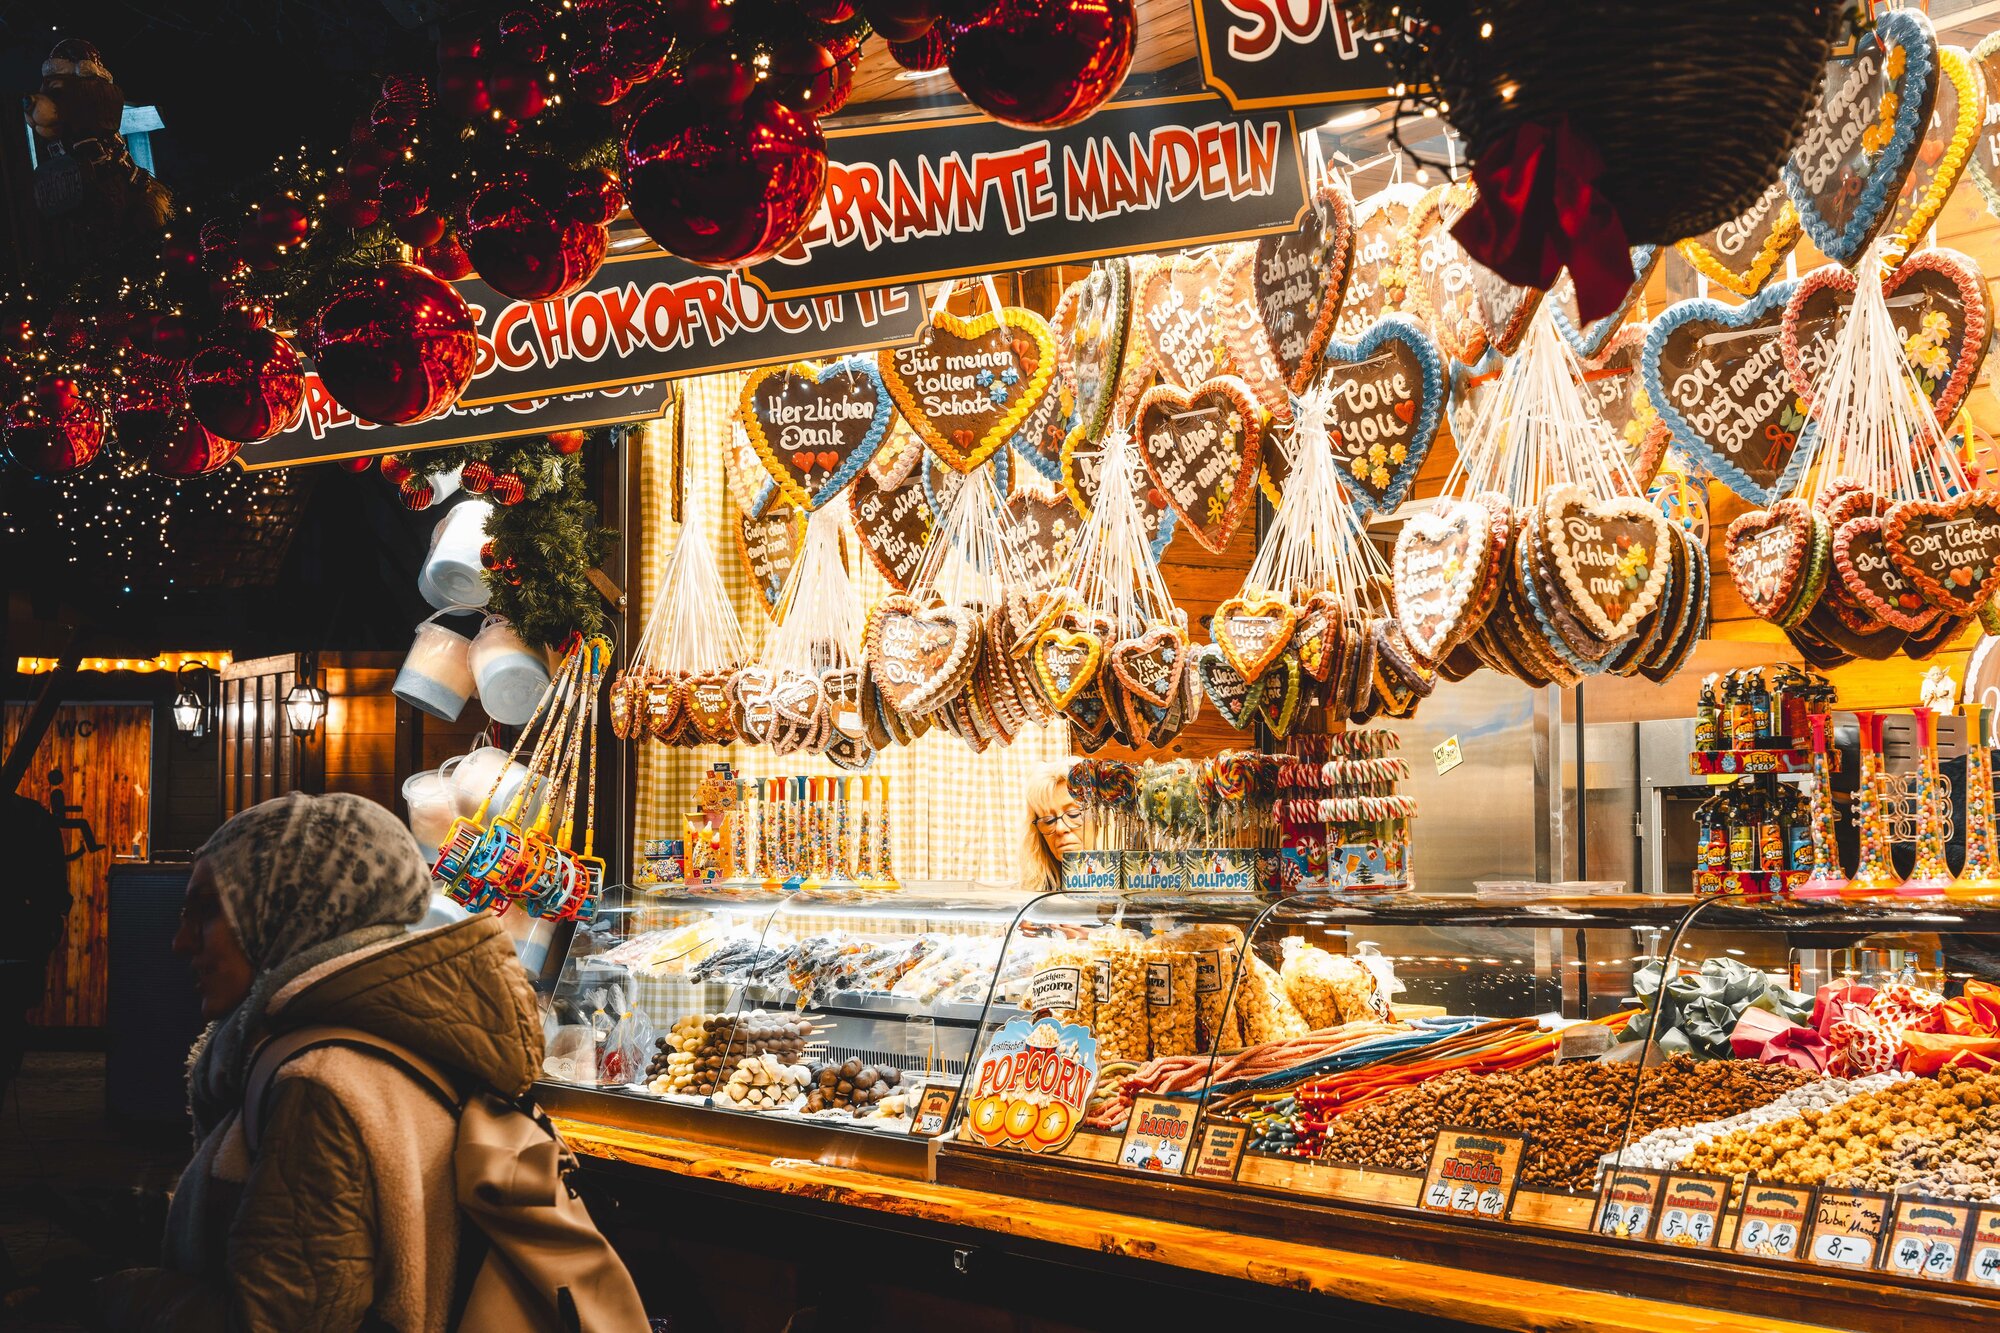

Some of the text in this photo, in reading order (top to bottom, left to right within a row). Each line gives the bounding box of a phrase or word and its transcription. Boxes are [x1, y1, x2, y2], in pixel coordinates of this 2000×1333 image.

[1826, 55, 1877, 124] mein
[774, 120, 1282, 266] BRANNTE MANDELN
[896, 346, 1014, 376] Für meinen
[1731, 343, 1780, 395] mein
[914, 370, 975, 395] tollen
[1673, 357, 1722, 409] Du
[769, 395, 875, 425] Herzlichen
[923, 394, 997, 418] Schatz
[780, 426, 846, 450] Dank
[867, 516, 893, 550] bist
[1565, 516, 1604, 543] Du
[1906, 523, 2000, 556] Der lieben
[883, 532, 907, 561] für
[1571, 544, 1622, 574] fehlst
[1931, 547, 1989, 571] Mami
[1590, 575, 1624, 596] mir
[1230, 624, 1265, 637] Miss
[1235, 638, 1263, 653] you
[1130, 655, 1156, 675] Viel
[1139, 664, 1172, 687] Glück
[56, 719, 95, 738] WC
[1066, 874, 1115, 889] LOLLIPOPS
[1128, 873, 1182, 890] LOLLIPOPS
[1191, 872, 1248, 888] LOLLIPOPS
[974, 1050, 1093, 1112] POPCORN
[1137, 1110, 1189, 1140] Lassos
[1126, 1148, 1137, 1163] 2
[1164, 1153, 1177, 1165] 5
[1441, 1157, 1503, 1185] Mandeln
